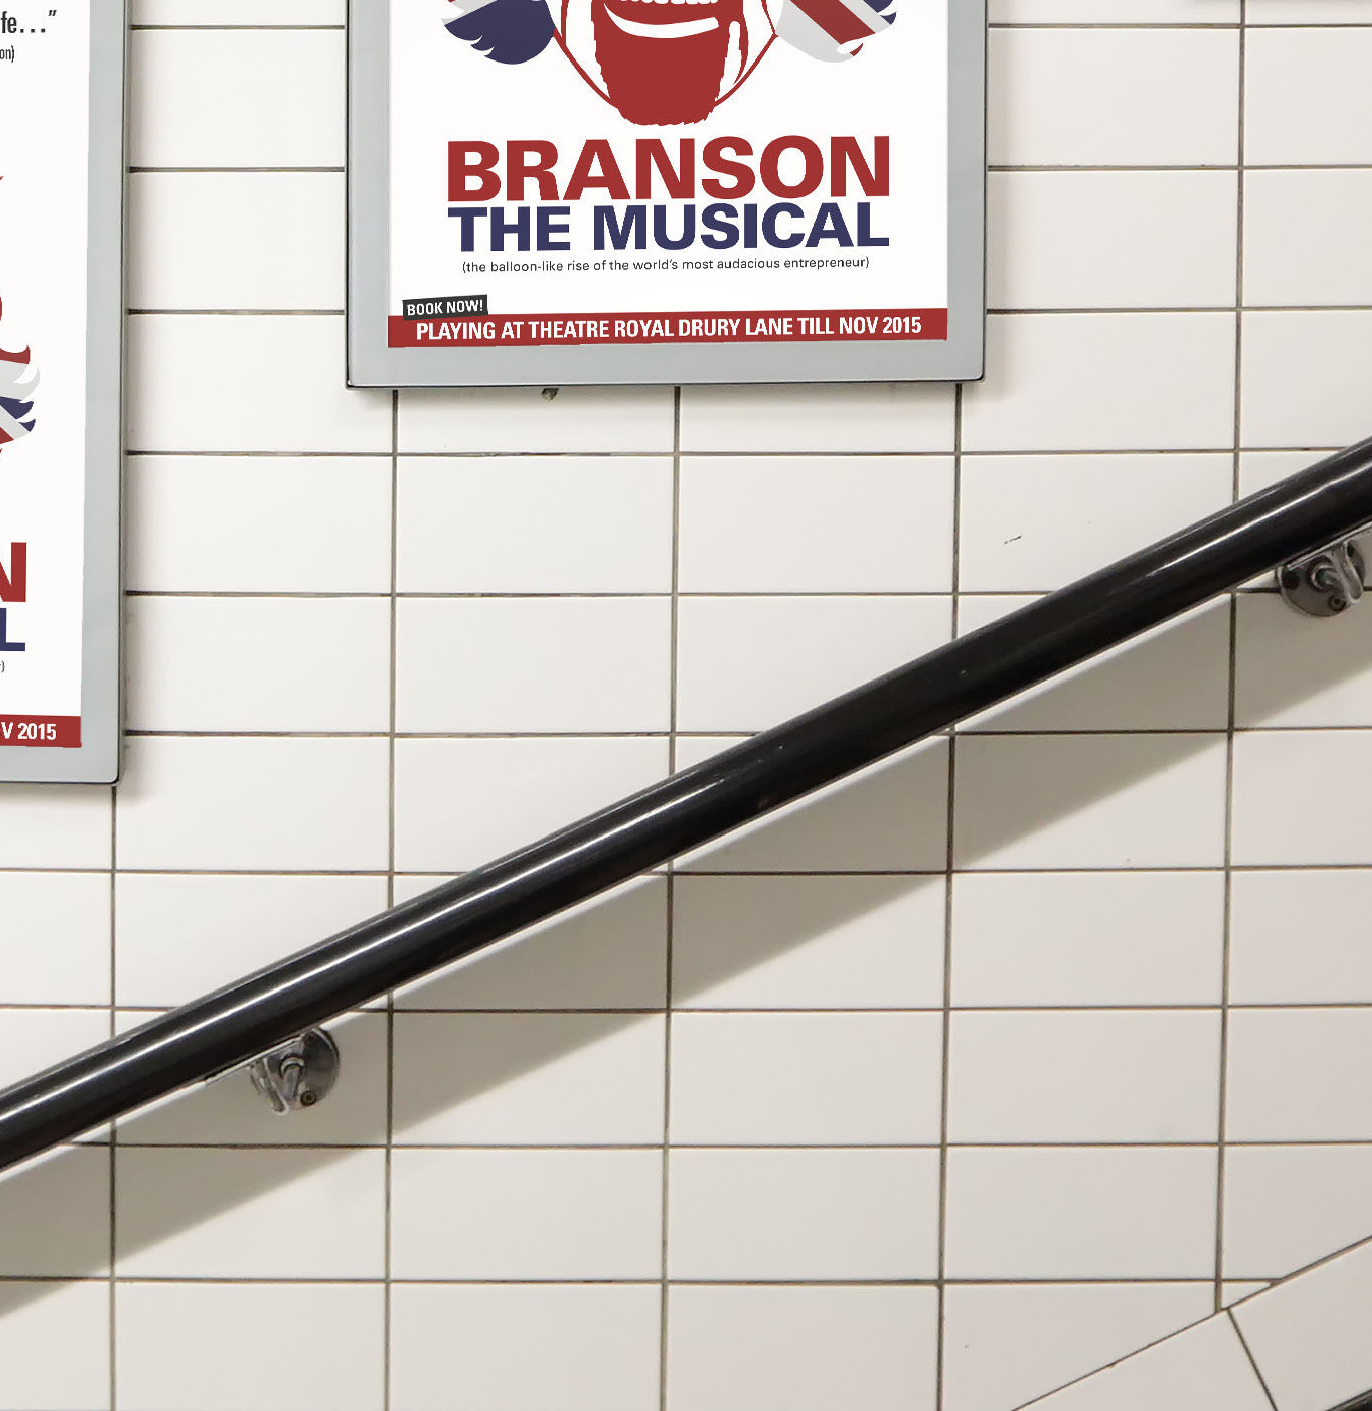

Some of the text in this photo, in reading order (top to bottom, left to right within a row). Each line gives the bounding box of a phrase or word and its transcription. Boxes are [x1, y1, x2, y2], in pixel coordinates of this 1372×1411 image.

[447, 134, 890, 202] BRANSON
[447, 201, 890, 252] THE MUSICAL
[462, 256, 870, 274] (the balloon-like rise of the world’s most audacious entrepreneur)
[406, 299, 483, 316] BOOK NOW!
[416, 316, 922, 340] PLAYING AT THEATRE ROYAL DRURY LANE TILL NOV 2015
[17, 722, 57, 741] 2015
